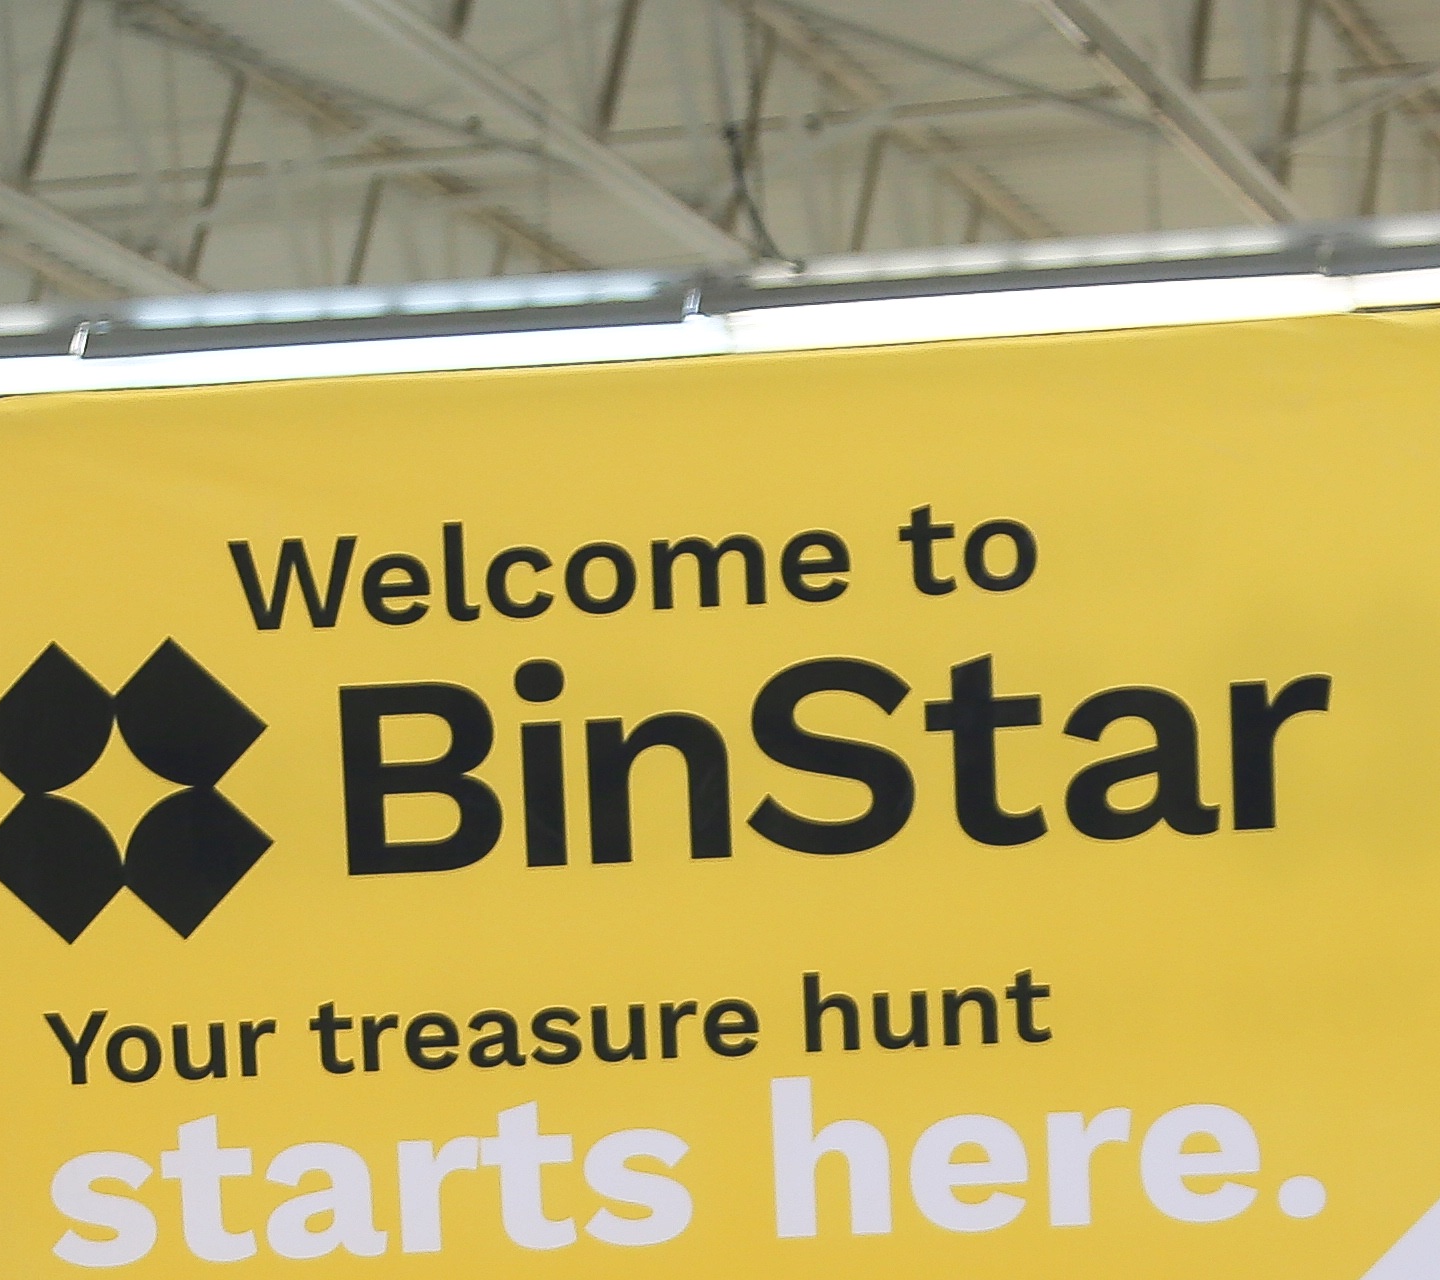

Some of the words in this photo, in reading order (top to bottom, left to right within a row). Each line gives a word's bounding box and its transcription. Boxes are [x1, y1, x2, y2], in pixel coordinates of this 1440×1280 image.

[226, 520, 851, 631] Welcome
[898, 504, 1038, 597] to
[339, 654, 1332, 876] BinStar
[44, 1009, 276, 1085] Your
[309, 988, 760, 1075] treasure
[803, 968, 1052, 1053] hunt
[50, 1101, 694, 1269] starts
[770, 1076, 1328, 1239] here.
